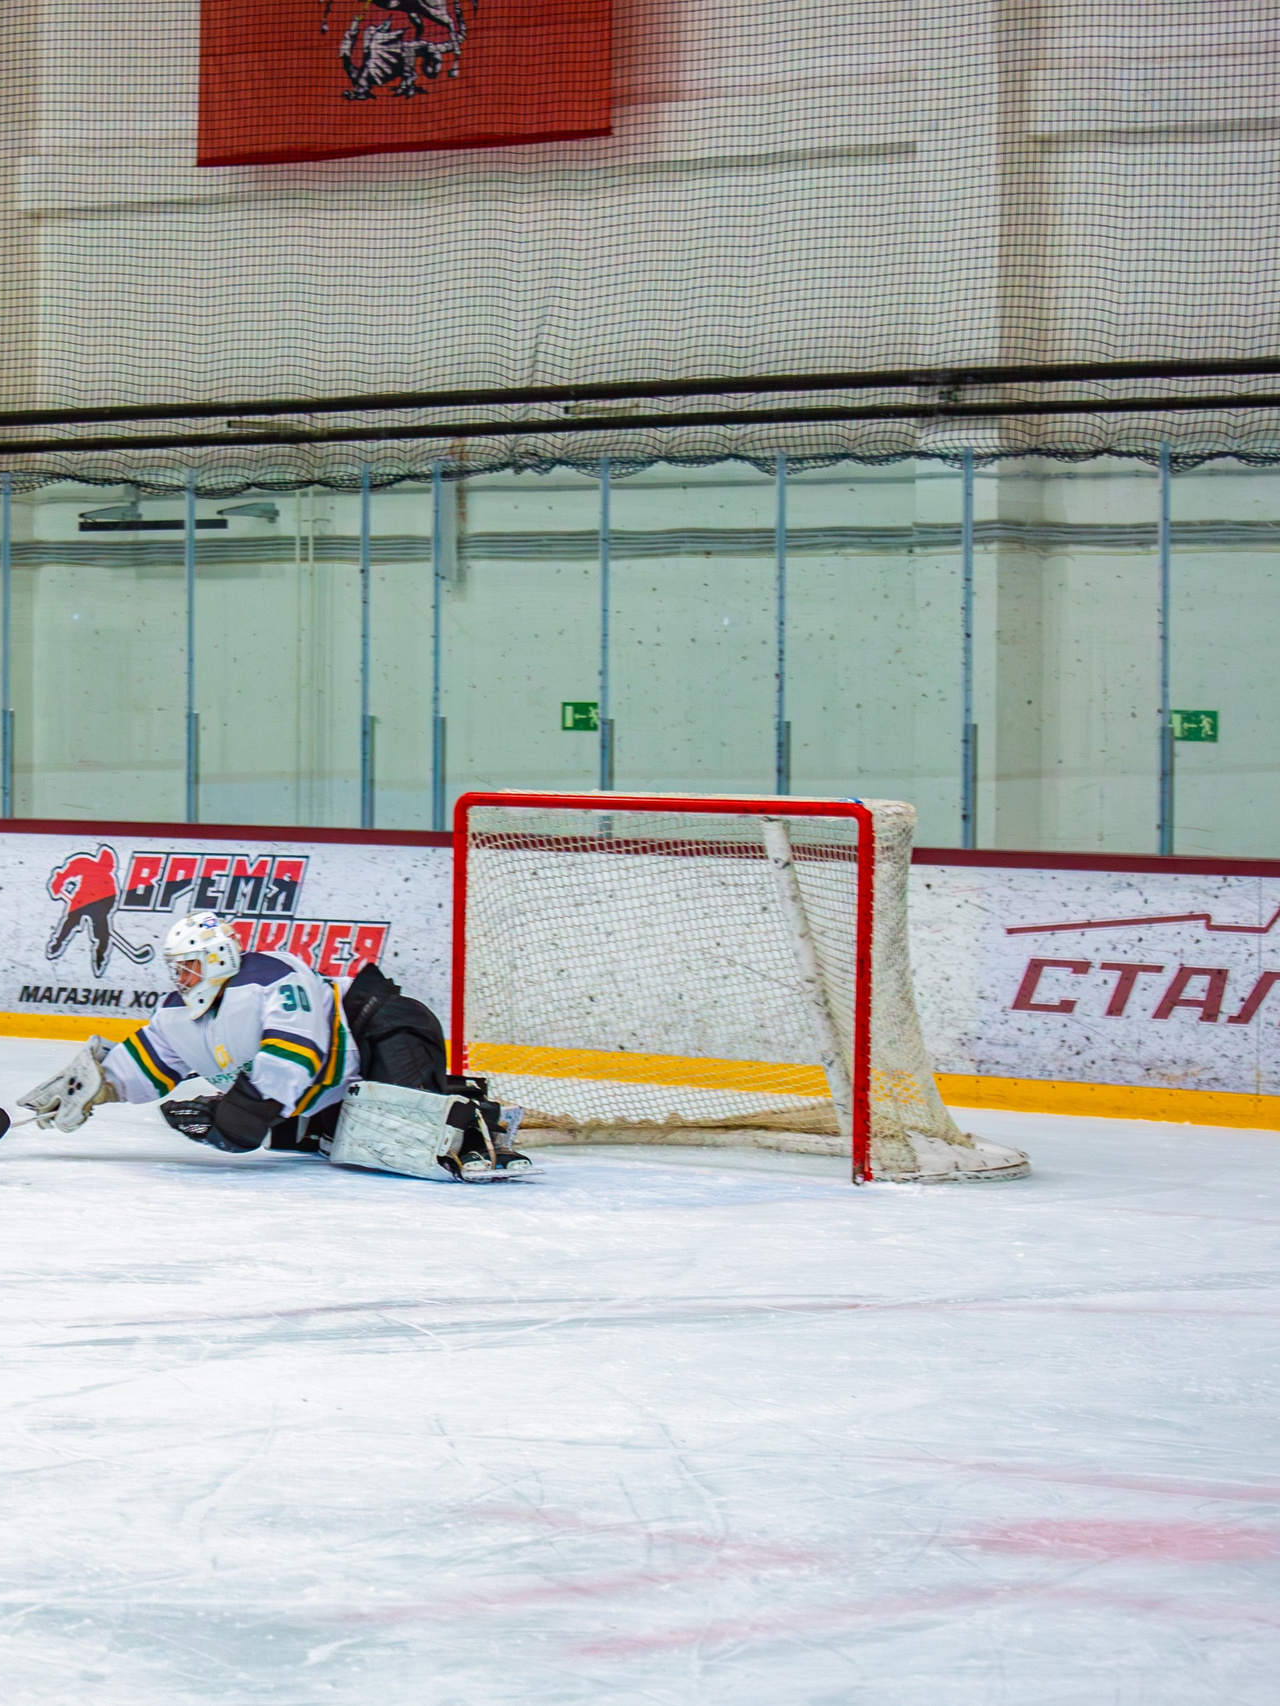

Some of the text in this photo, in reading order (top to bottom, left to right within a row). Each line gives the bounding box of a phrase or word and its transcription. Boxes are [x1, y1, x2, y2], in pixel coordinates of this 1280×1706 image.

[118, 851, 310, 915] ВРЕМЯ
[21, 985, 167, 1009] МАГАЗИН ХО
[279, 984, 311, 1012] 30
